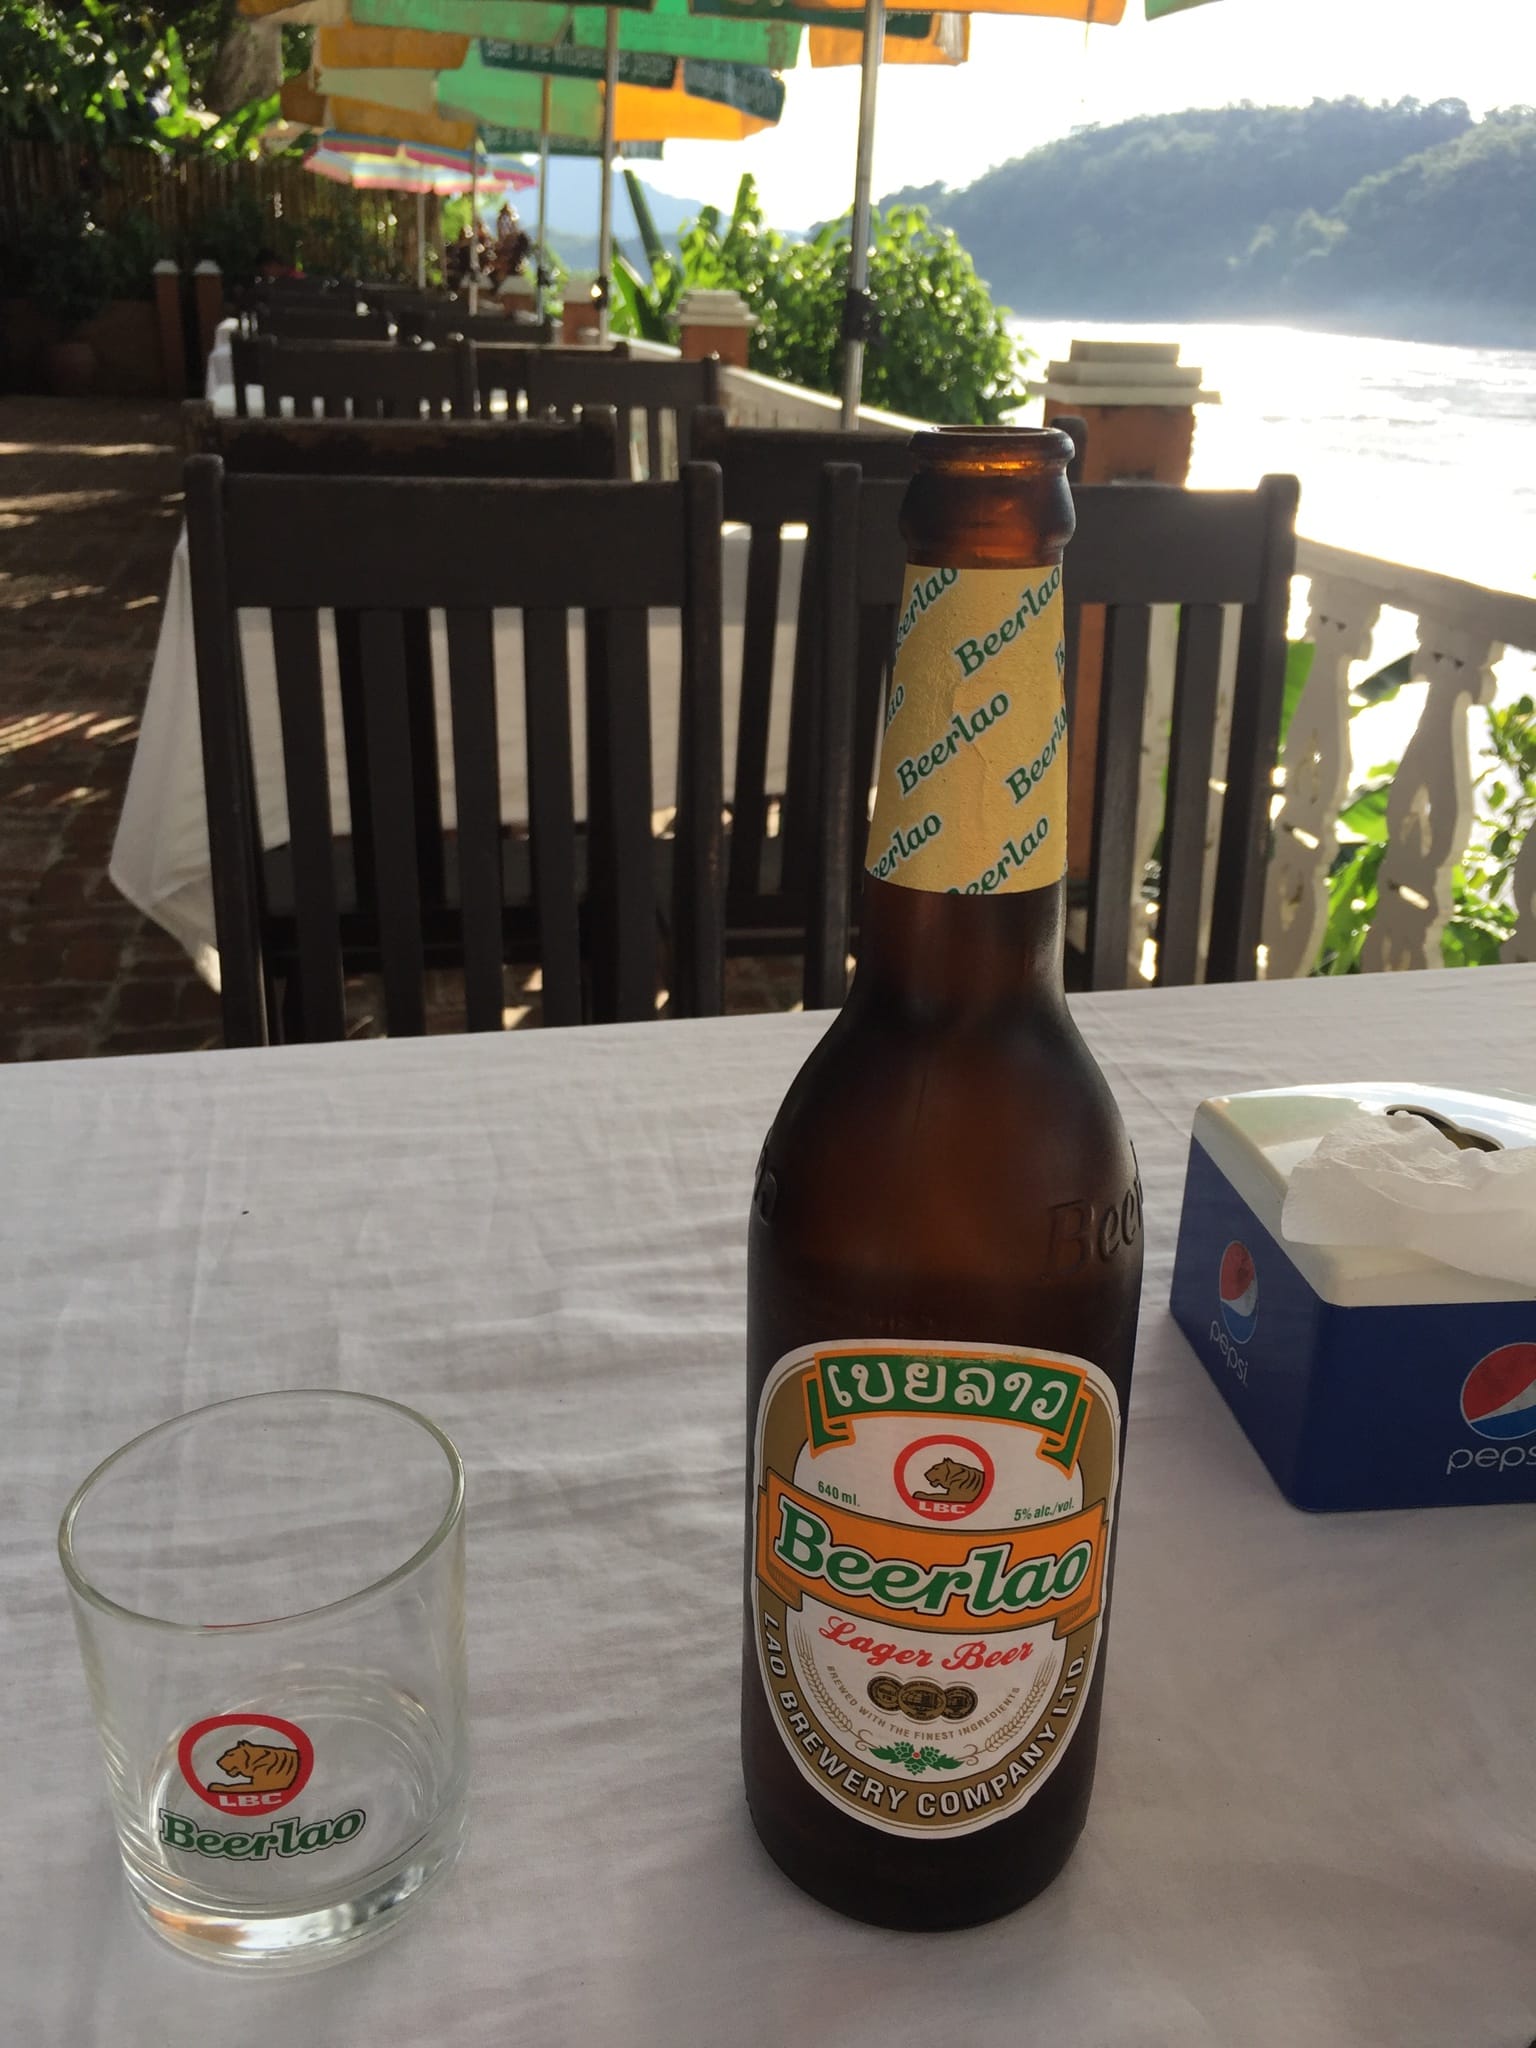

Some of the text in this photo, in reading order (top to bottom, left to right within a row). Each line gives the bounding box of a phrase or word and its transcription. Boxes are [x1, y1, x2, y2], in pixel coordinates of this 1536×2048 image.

[896, 567, 958, 646] eerlao
[954, 566, 1061, 677] Beerlao
[898, 692, 1010, 795] Beerlao
[1005, 705, 1068, 804] Beerla
[871, 813, 942, 879] eerlao
[946, 816, 1050, 895] eerlao
[1210, 1320, 1249, 1386] pepsi
[826, 1361, 1069, 1421] ເບຍລາວ
[817, 1480, 861, 1508] 640 ml.
[918, 1502, 967, 1514] LBC
[1013, 1507, 1032, 1521] 5%
[774, 1495, 1093, 1616] Beerlao
[818, 1615, 1034, 1671] Lager Beer
[763, 1610, 788, 1678] LAO
[779, 1689, 909, 1813] BREWERY
[916, 1721, 1058, 1818] COMPANY
[1051, 1645, 1088, 1717] LTD.
[826, 1665, 858, 1707] BREWED
[858, 1705, 887, 1729] WITH
[889, 1723, 911, 1738] THE
[913, 1730, 955, 1742] FINEST
[958, 1686, 1021, 1737] INGREDIENTS
[218, 1791, 283, 1808] LBC
[158, 1808, 367, 1862] Beerlao
